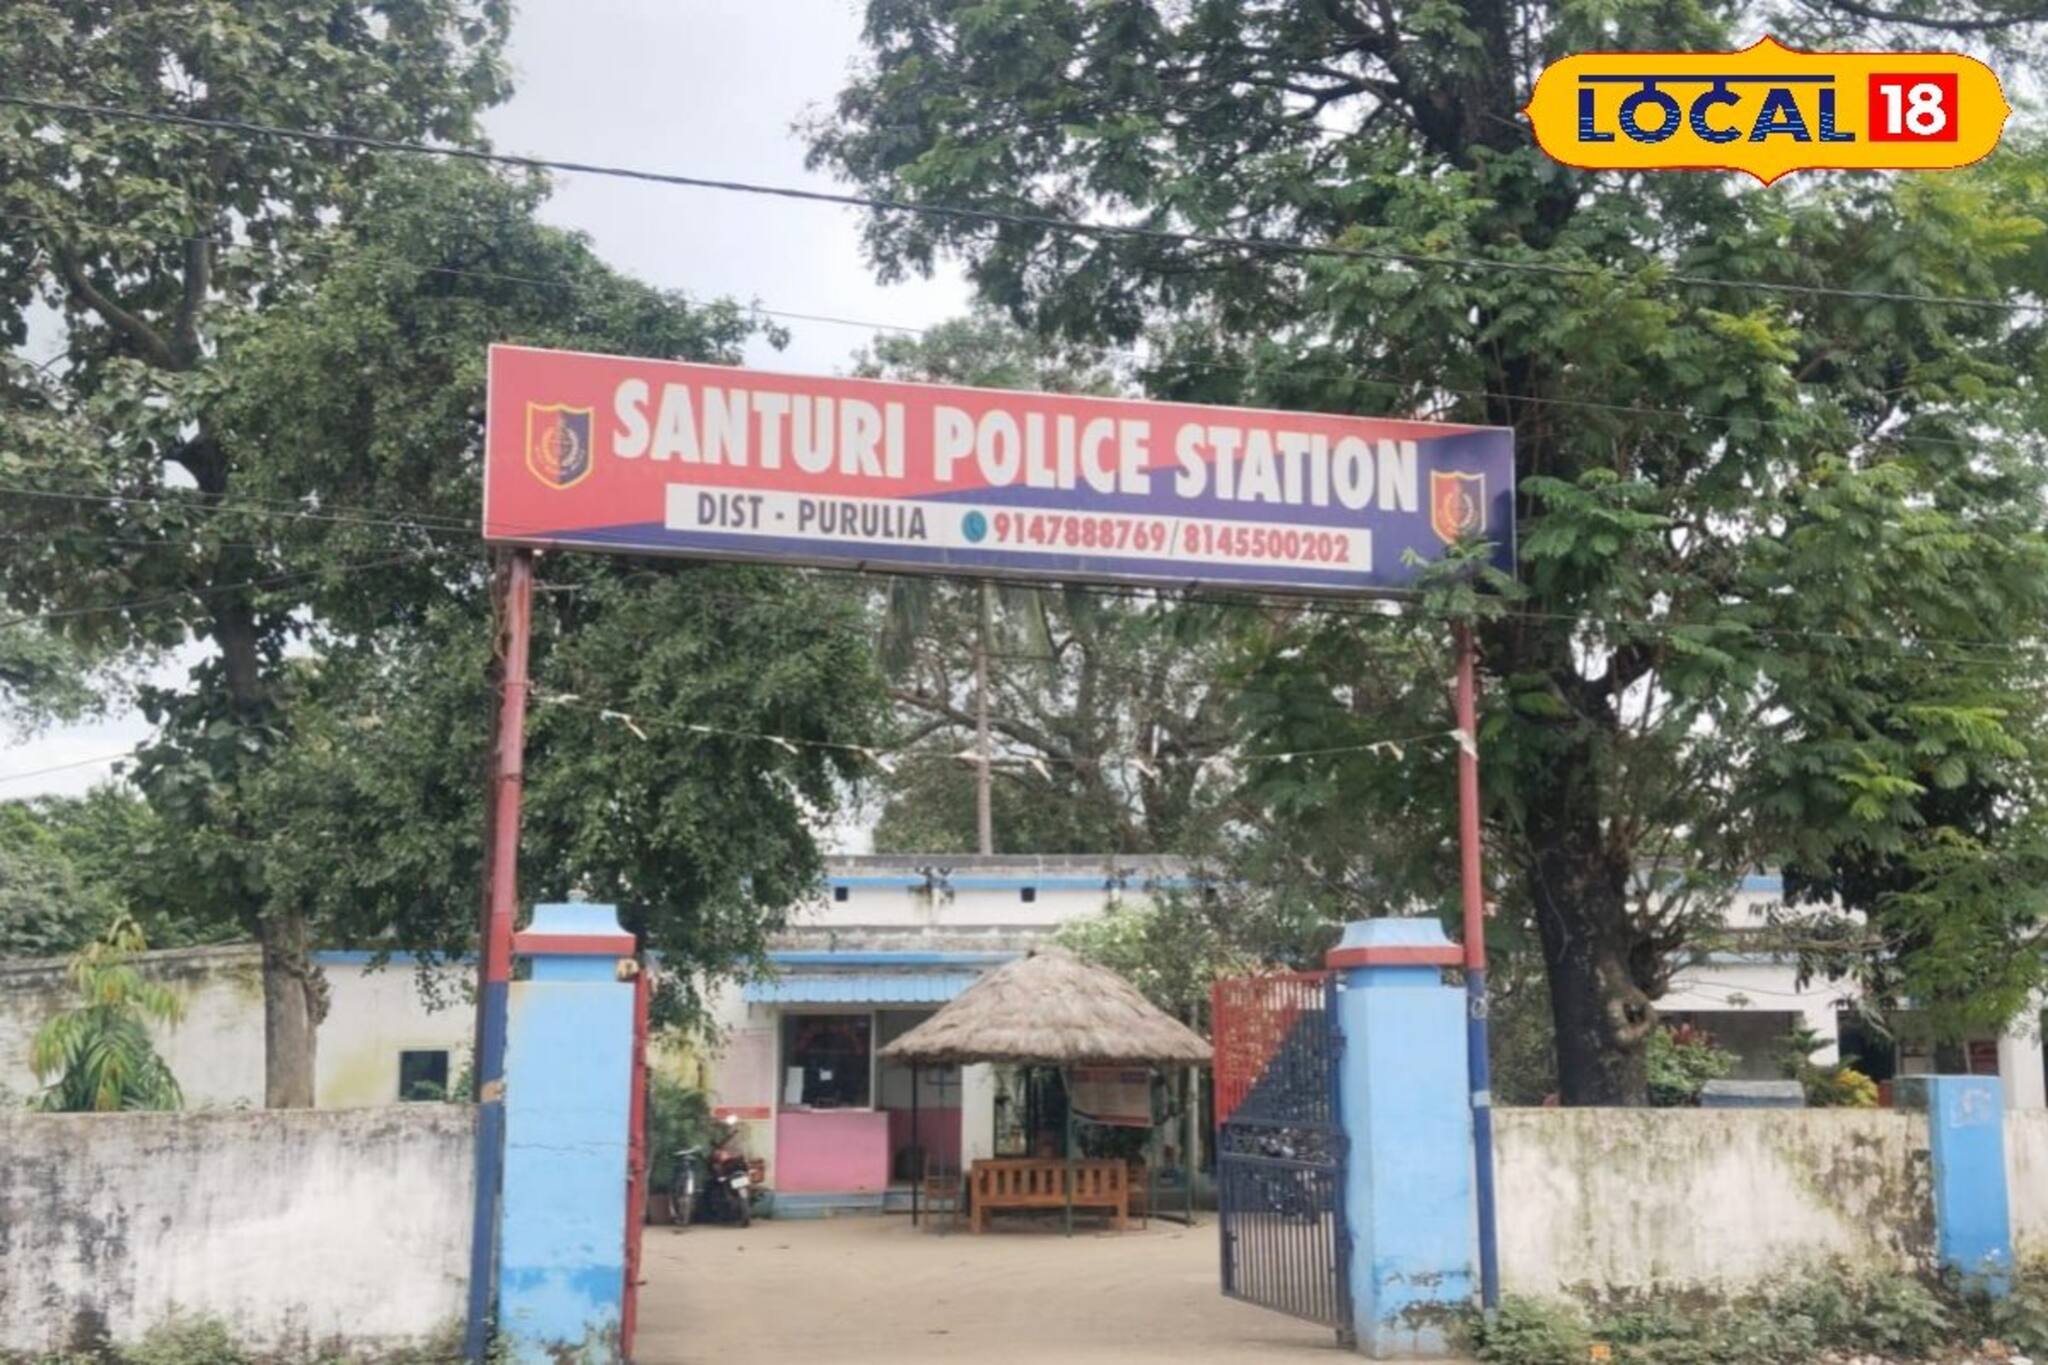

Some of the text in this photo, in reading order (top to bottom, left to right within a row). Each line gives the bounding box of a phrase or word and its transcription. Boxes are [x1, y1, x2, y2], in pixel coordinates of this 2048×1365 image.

[612, 378, 1419, 513] SANTURI POLICE STATION
[696, 491, 764, 529] DIST
[798, 498, 927, 541] PURULIA
